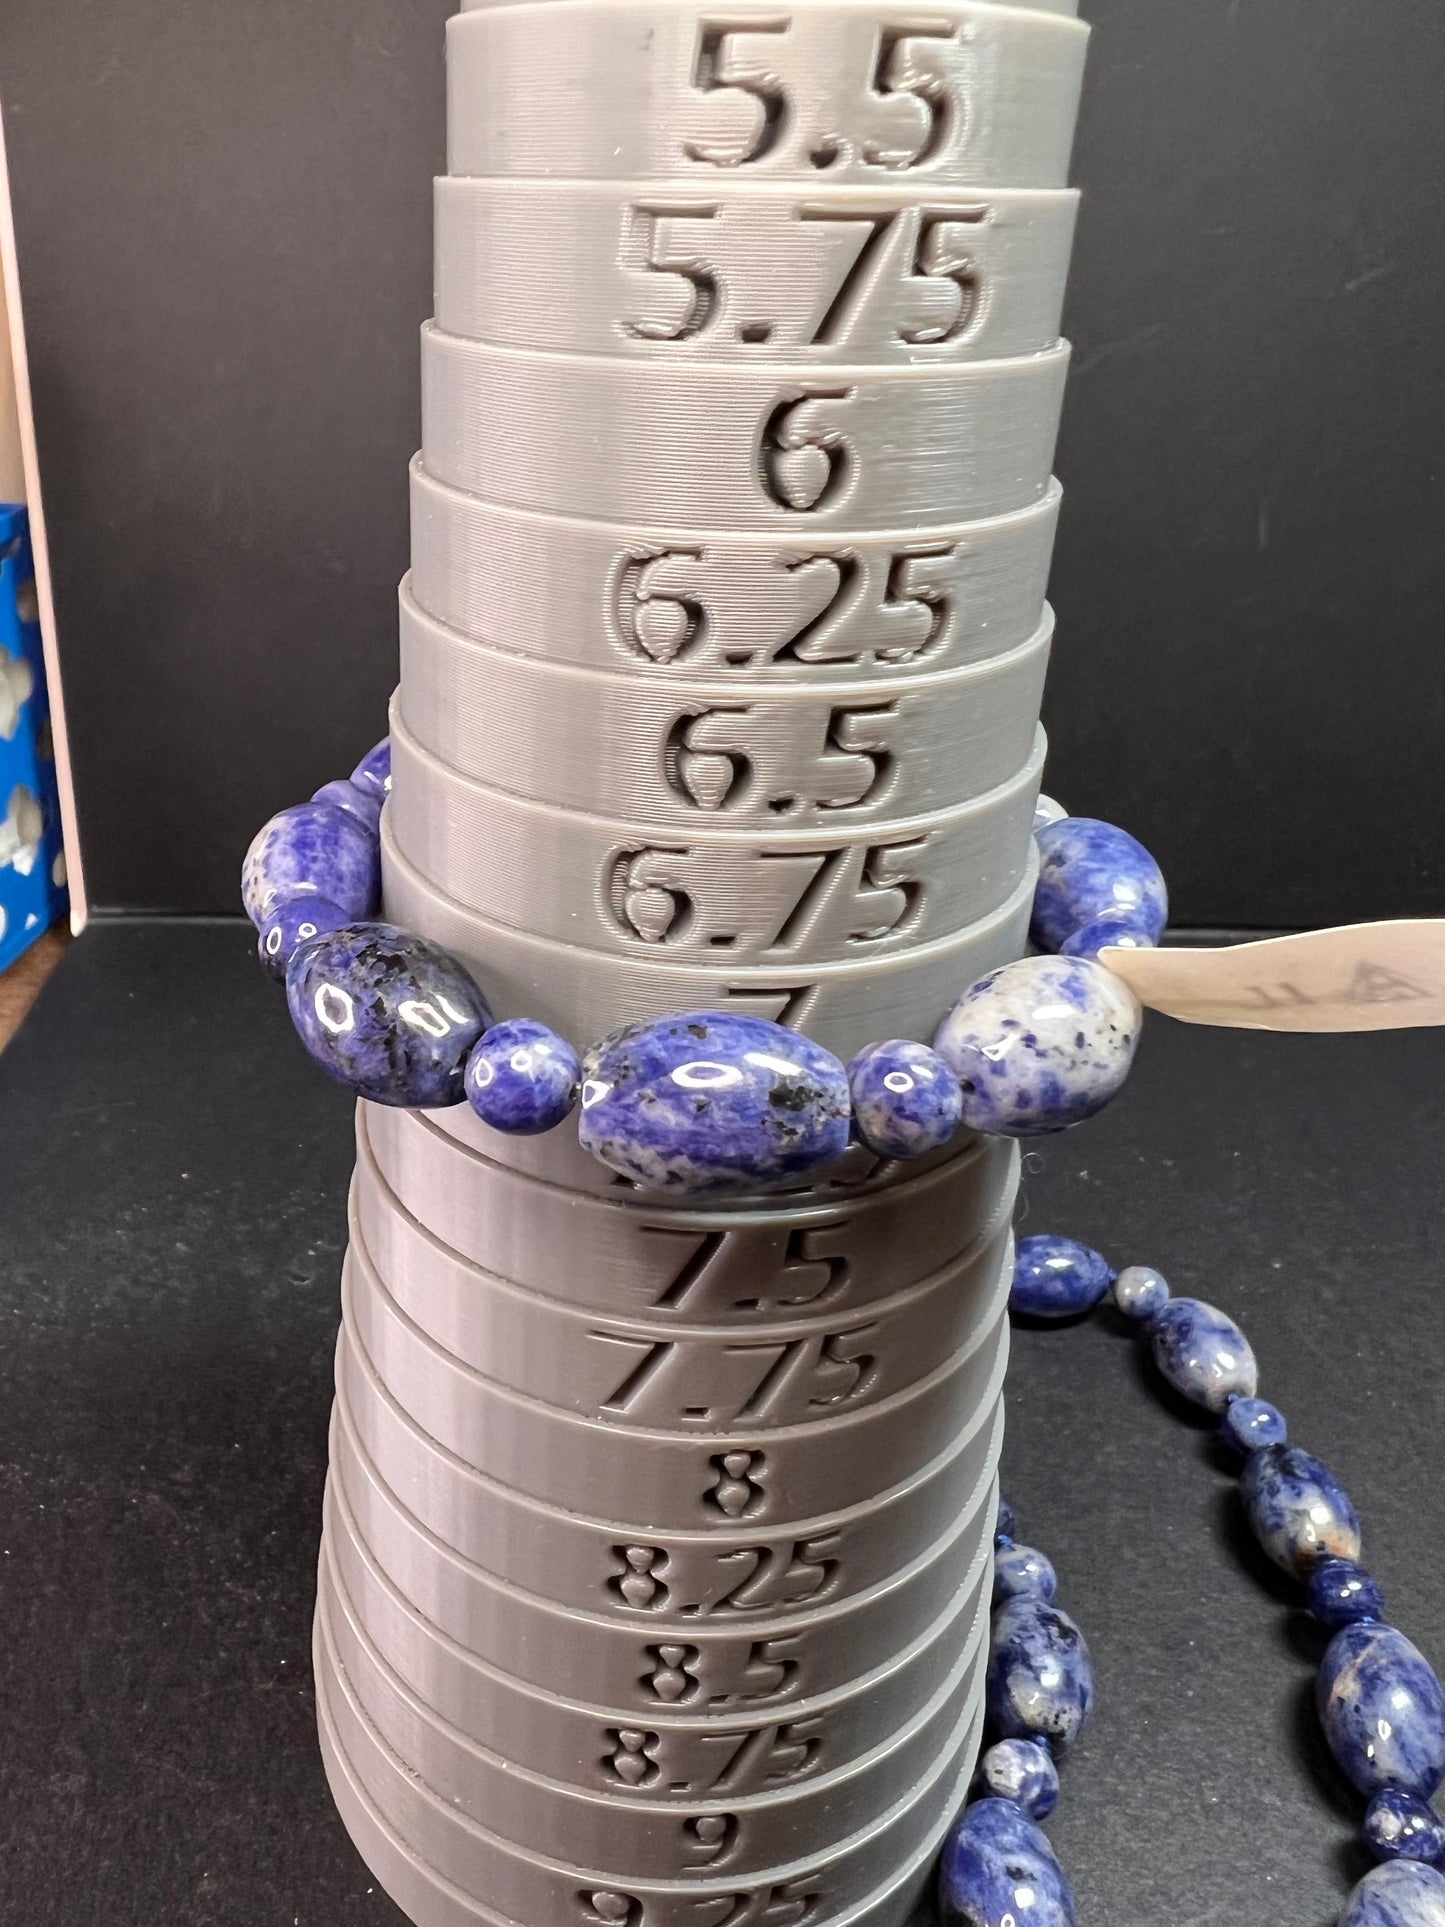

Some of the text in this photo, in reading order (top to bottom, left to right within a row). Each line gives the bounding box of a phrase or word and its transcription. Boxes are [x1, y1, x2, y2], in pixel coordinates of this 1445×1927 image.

[684, 16, 968, 172] 5.5
[616, 200, 996, 345] 5.75
[756, 386, 858, 512] 6
[604, 540, 968, 668] 6.25
[664, 698, 906, 814] 6.5
[596, 832, 938, 954] 6.75
[640, 1220, 852, 1311] 7.5
[588, 1323, 880, 1422] 7.75
[703, 1449, 768, 1520] 8
[606, 1530, 846, 1617] 8.25
[638, 1634, 804, 1706] 8.5
[599, 1716, 828, 1792] 8.75
[682, 1812, 740, 1870] 9
[574, 1874, 830, 1927] 925
